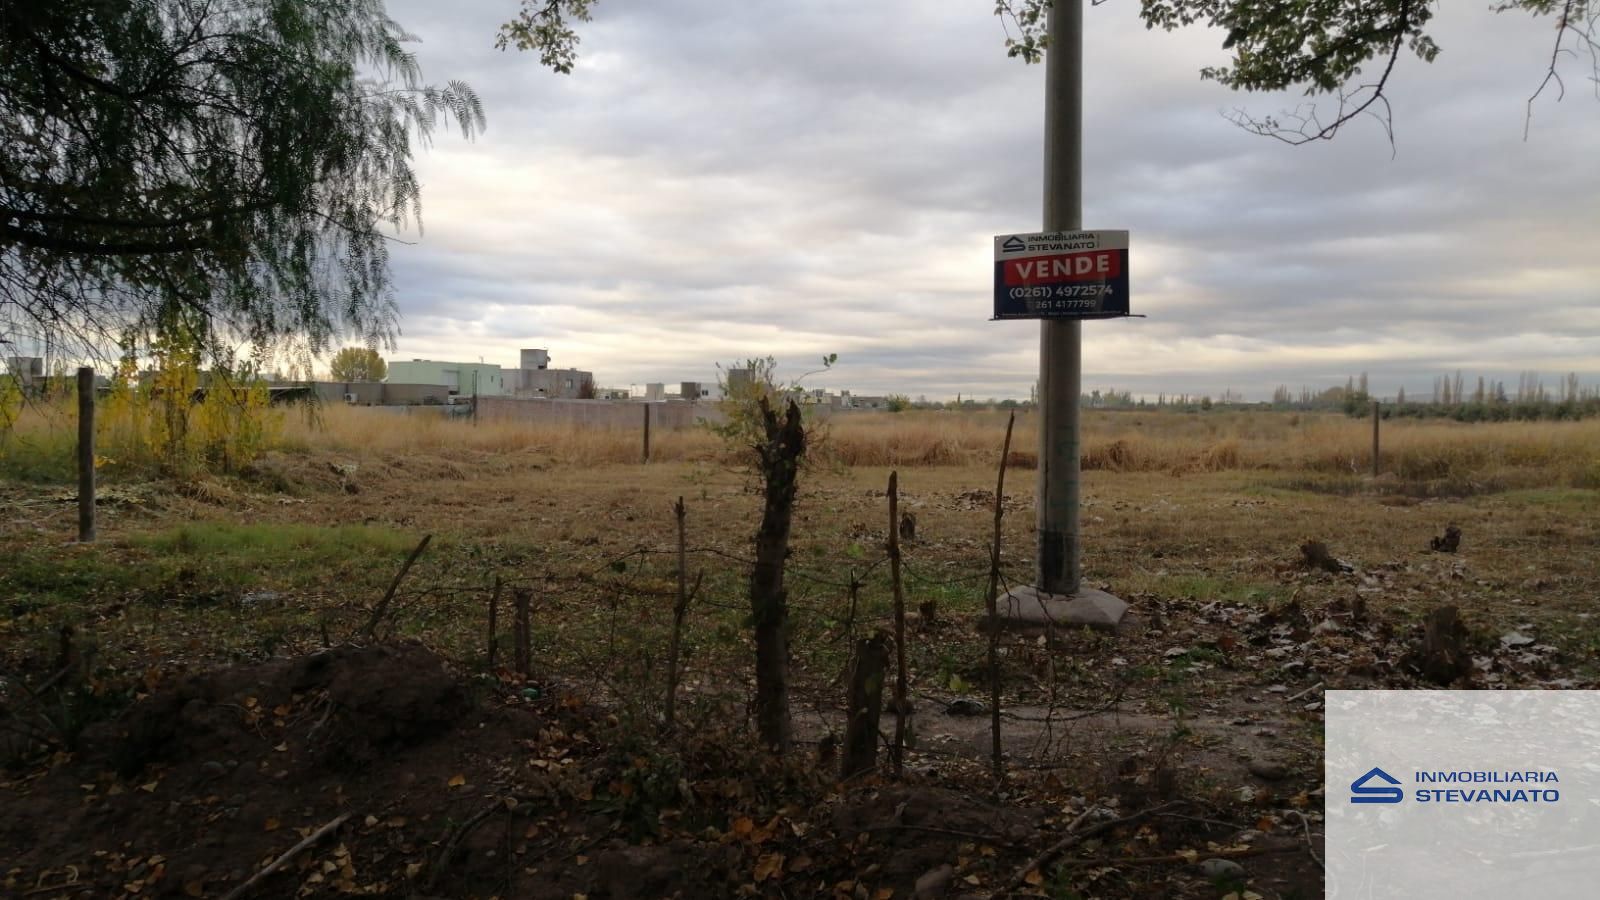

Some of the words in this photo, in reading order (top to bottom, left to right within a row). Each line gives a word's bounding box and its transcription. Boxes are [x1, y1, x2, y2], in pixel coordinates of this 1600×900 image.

[1028, 233, 1095, 242] INMOBILIARIA
[1028, 242, 1095, 251] STEVANATO
[1016, 255, 1110, 279] VENDE
[1009, 286, 1052, 299] (0261)
[1056, 285, 1113, 296] 4972574
